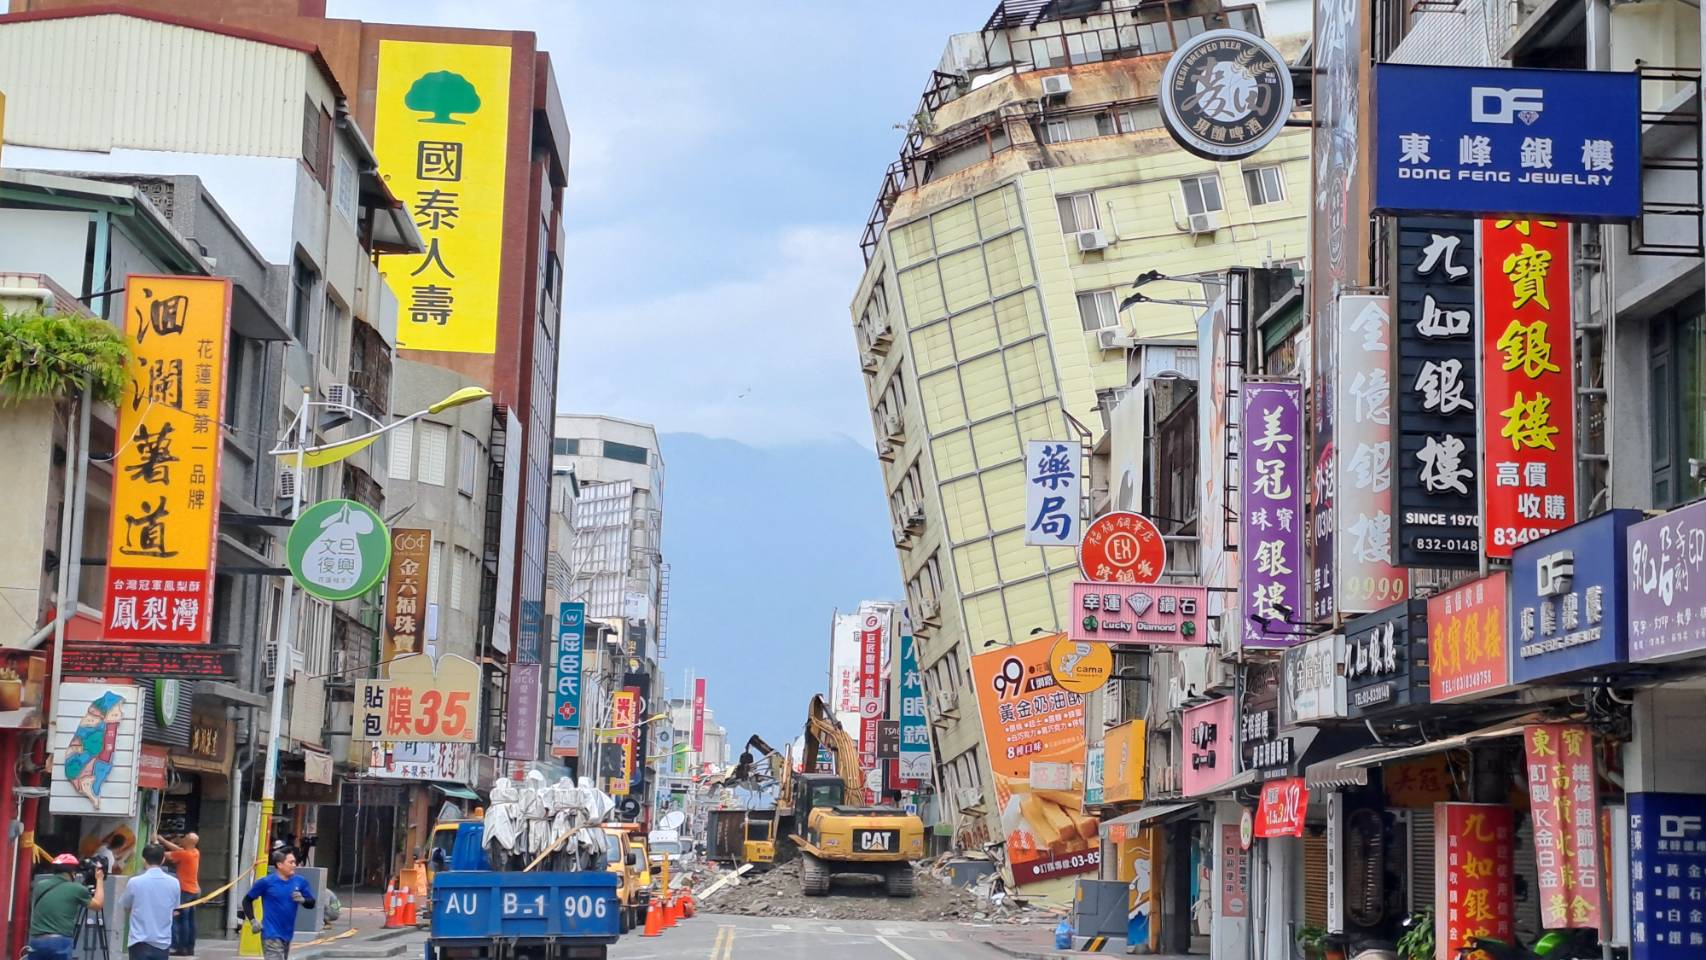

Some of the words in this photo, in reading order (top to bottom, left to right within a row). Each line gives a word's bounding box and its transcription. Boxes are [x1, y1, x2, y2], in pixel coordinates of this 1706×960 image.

[1175, 65, 1190, 91] FRESH
[1186, 41, 1218, 65] BREWED
[1219, 40, 1242, 50] BEER
[1471, 86, 1544, 124] DF
[1398, 132, 1614, 172] 東峰銀樓
[1398, 167, 1451, 181] DONG
[1458, 169, 1511, 183] FENG
[1517, 172, 1614, 187] JEWELRY
[407, 140, 464, 326] 國泰人壽
[1415, 233, 1475, 495] 九如銀樓
[119, 287, 190, 558] 洄瀾薯道
[187, 338, 214, 511] 花蓮薯第一品牌
[1252, 405, 1294, 500] 美冠
[1495, 461, 1547, 487] 高價
[1030, 443, 1076, 541] 藥局
[1405, 512, 1447, 526] SINCE
[1517, 493, 1566, 520] 收購
[1251, 507, 1294, 534] 珠寶
[319, 537, 356, 556] 文旦
[1416, 538, 1478, 551] 832-0148
[318, 556, 356, 576] 復興
[112, 578, 201, 593] 台灣冠軍鳳梨酥
[1252, 539, 1294, 623] 銀樓
[1345, 575, 1405, 601] 9999
[110, 595, 199, 632] 鳳梨灣
[393, 557, 421, 653] 金六福珠寶
[1083, 592, 1122, 613] 幸運
[1157, 595, 1198, 616] 鑽石
[1102, 620, 1133, 634] Lucky
[1136, 620, 1177, 634] Diamond
[559, 631, 581, 697] 屈臣氏
[1076, 665, 1103, 675] cama
[993, 657, 1024, 701] 99
[1531, 728, 1585, 757] 東寶
[1659, 814, 1702, 838] DF
[861, 831, 892, 851] CAT
[445, 892, 478, 915] AU
[564, 895, 607, 918] 906
[1547, 893, 1596, 924] 黃金
[1667, 908, 1703, 923] 白金
